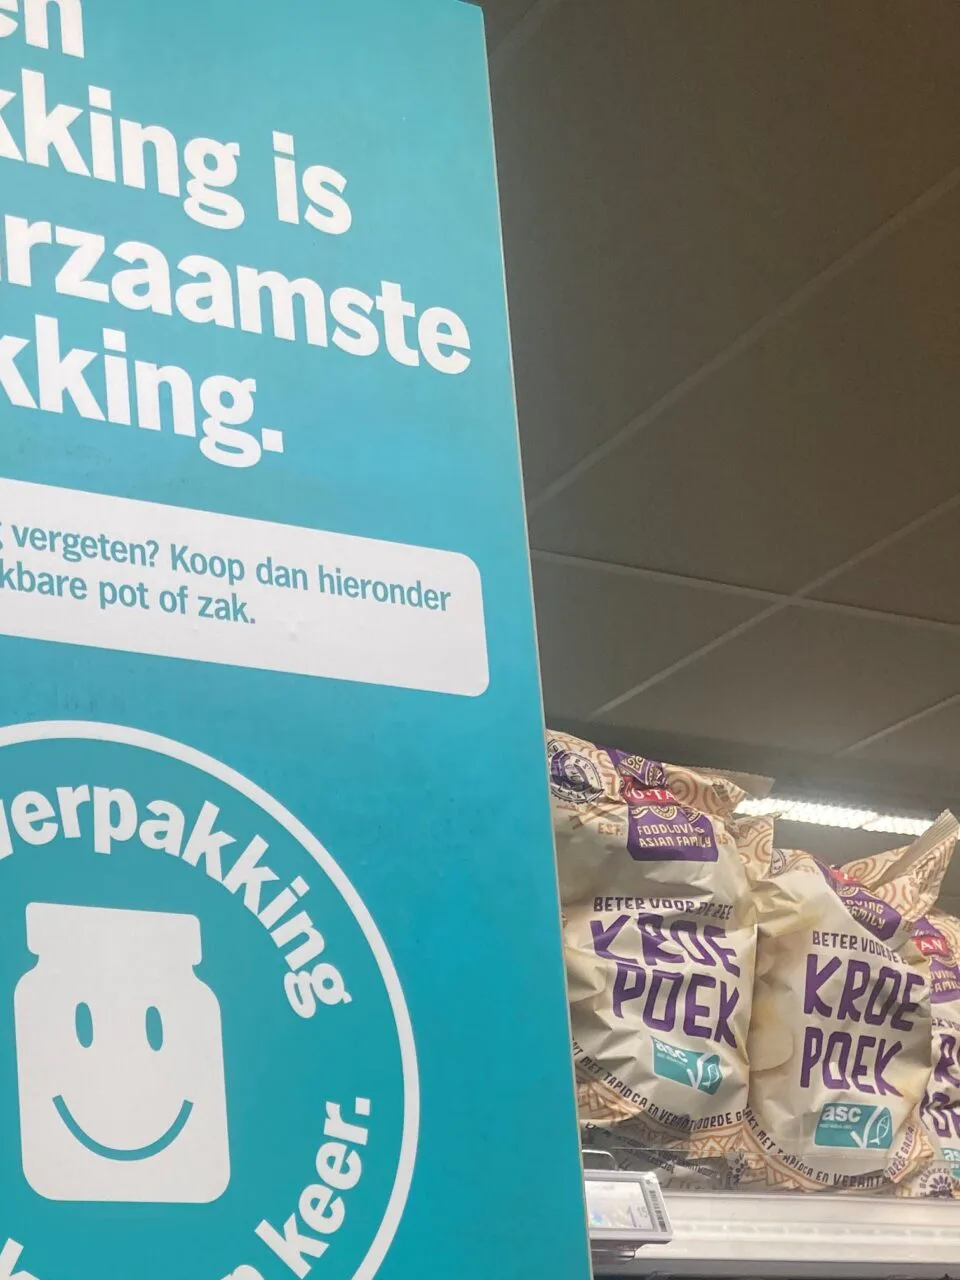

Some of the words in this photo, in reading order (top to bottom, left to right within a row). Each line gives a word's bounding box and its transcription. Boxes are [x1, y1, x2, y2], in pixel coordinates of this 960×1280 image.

[273, 131, 353, 236] is
[11, 519, 161, 576] vergeten?
[170, 543, 246, 591] Koop
[255, 555, 309, 593] dan
[317, 563, 453, 614] hieronder
[98, 576, 151, 617] pot
[158, 580, 190, 618] of
[197, 590, 258, 627] zak.
[639, 836, 675, 849] ASIAN
[593, 896, 646, 912] BETER
[648, 897, 695, 914] VOOR
[589, 912, 741, 979] KROE
[811, 930, 858, 951] BETER
[612, 961, 740, 1049] POEK
[803, 953, 926, 1033] KROE
[580, 1056, 603, 1075] MET
[603, 1071, 648, 1109] TAPIOCA
[799, 1026, 905, 1098] POEK
[821, 1104, 862, 1124] asc
[757, 1130, 776, 1151] MET
[777, 1149, 814, 1177] TAPIOCA
[816, 1170, 829, 1183] EN
[254, 1096, 372, 1279] keer.
